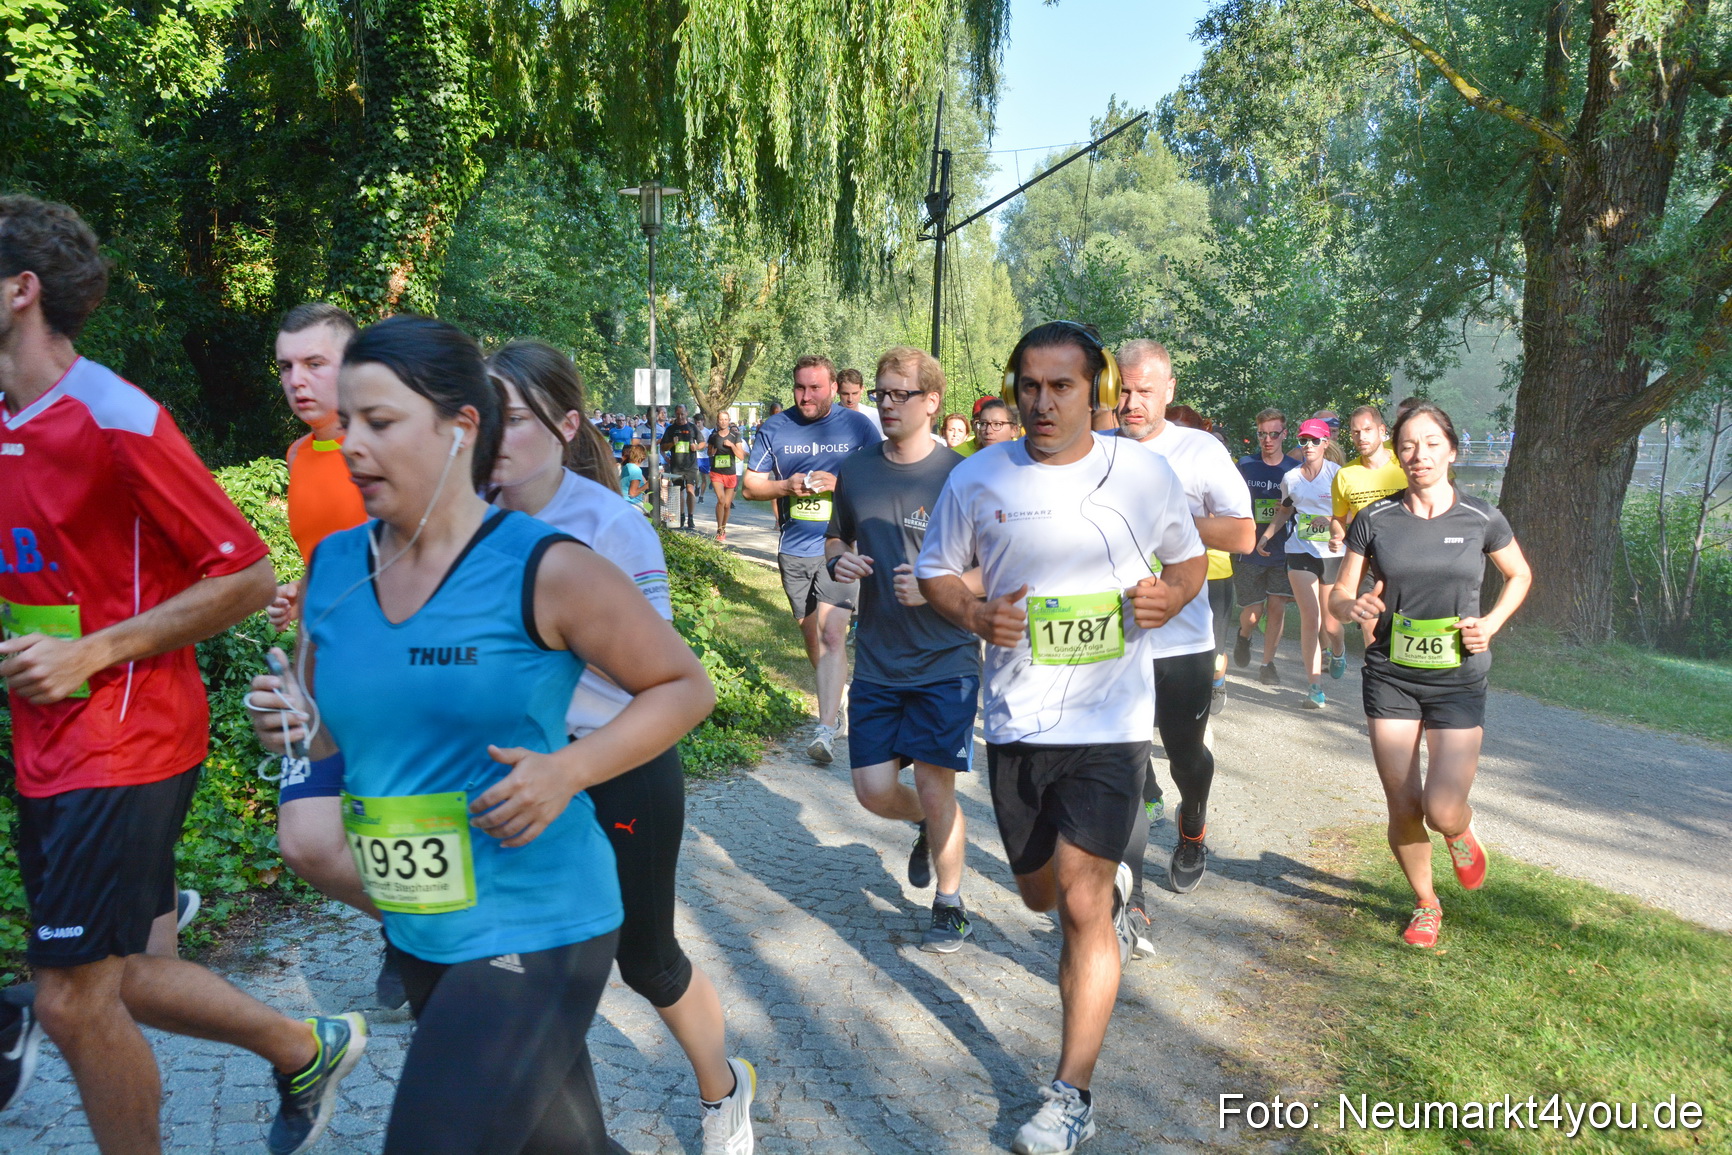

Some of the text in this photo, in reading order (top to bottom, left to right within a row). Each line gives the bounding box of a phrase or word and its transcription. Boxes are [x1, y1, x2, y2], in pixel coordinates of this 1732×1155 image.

[784, 443, 850, 454] EURO POLES
[1247, 479, 1267, 488] EURO
[796, 498, 821, 511] 525
[1007, 510, 1052, 518] SCHWARZ
[1262, 507, 1279, 517] 49
[1042, 617, 1111, 645] 1787
[1403, 635, 1443, 655] 746
[408, 647, 478, 666] THULE
[355, 836, 449, 880] 1933
[53, 925, 84, 938] JAKO
